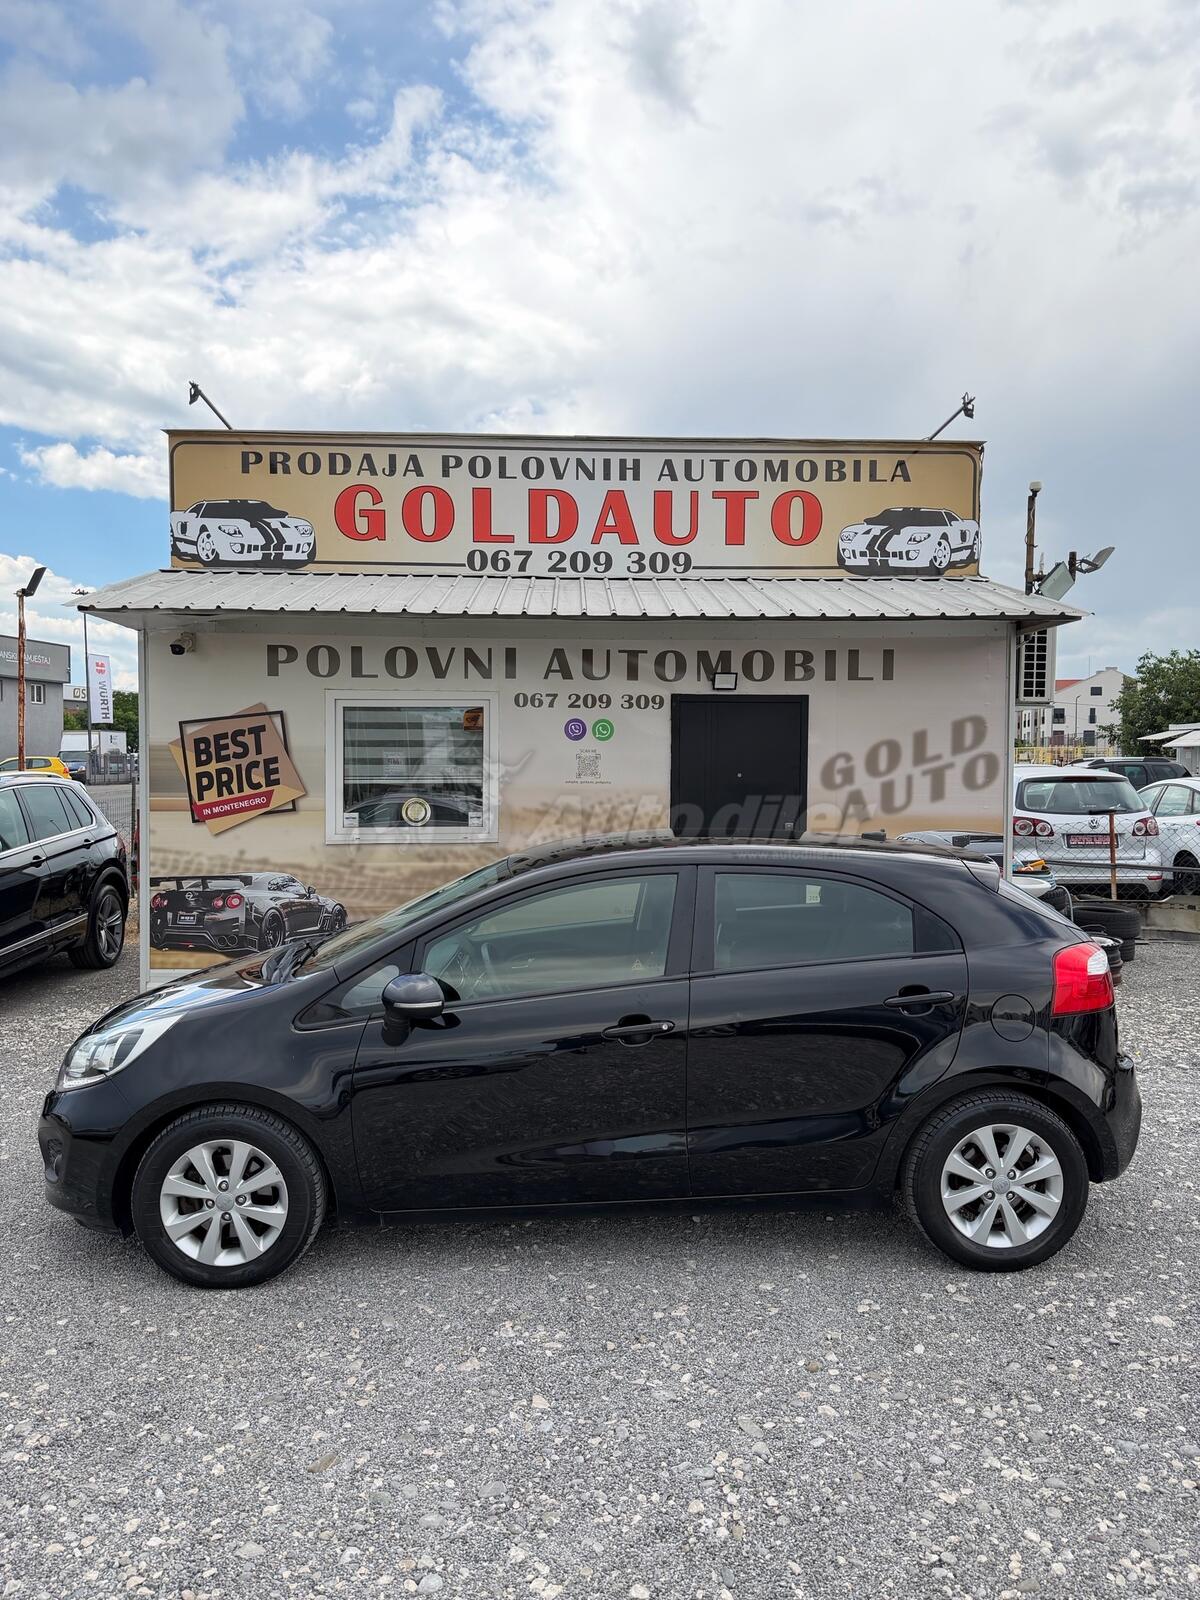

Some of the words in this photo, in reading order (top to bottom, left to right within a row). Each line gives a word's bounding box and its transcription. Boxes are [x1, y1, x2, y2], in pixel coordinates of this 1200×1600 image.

[241, 451, 424, 477] PRODAJA
[442, 455, 641, 480] POLOVNIH
[658, 458, 912, 482] AUTOMOBILA
[334, 483, 823, 546] GOLDAUTO
[467, 549, 533, 572] 067
[547, 550, 614, 574] 209
[626, 551, 693, 575] 309
[267, 644, 516, 679] POLOVNI
[543, 647, 895, 681] AUTOMOBILI
[98, 680, 111, 720] WÜRTH
[513, 692, 559, 708] 067
[567, 693, 612, 709] 209
[620, 694, 665, 710] 309
[193, 724, 266, 768] BEST
[820, 715, 988, 791] GOLD
[195, 756, 281, 802] PRICE
[838, 751, 1000, 832] AUTO
[203, 808, 212, 816] IN
[212, 796, 267, 814] MONTENEGRO
